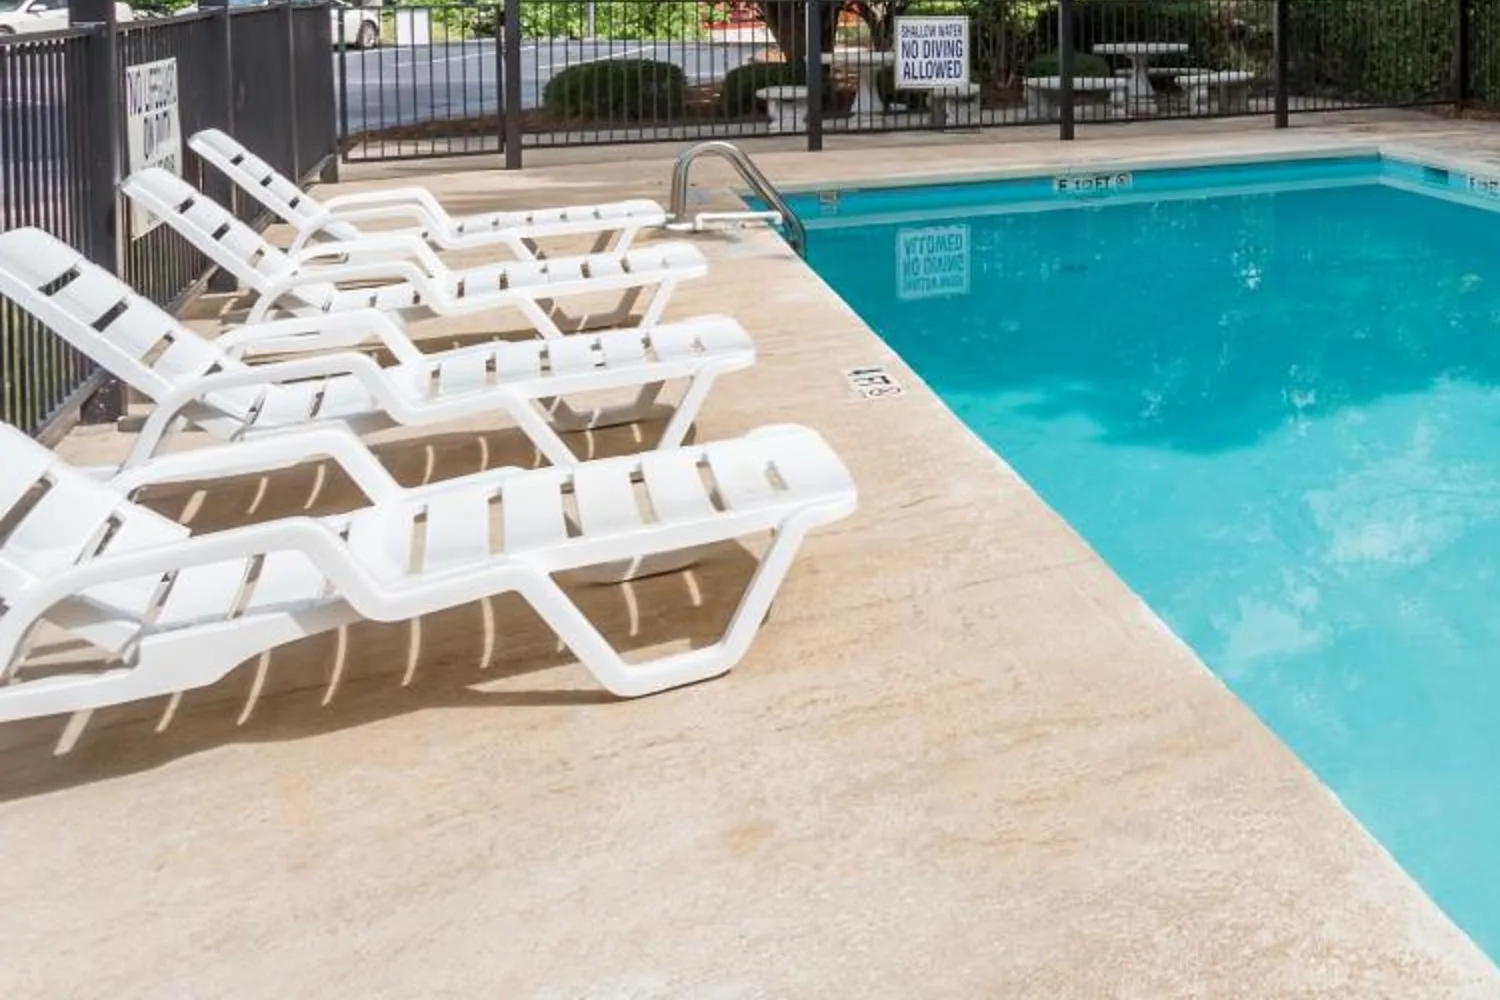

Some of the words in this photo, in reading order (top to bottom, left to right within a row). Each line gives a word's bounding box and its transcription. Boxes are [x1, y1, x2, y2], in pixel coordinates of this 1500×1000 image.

[901, 24, 936, 38] SHALLOW
[938, 23, 962, 37] WATER
[902, 40, 918, 59] NO
[923, 39, 963, 58] DIVING
[903, 60, 962, 80] ALLOWED
